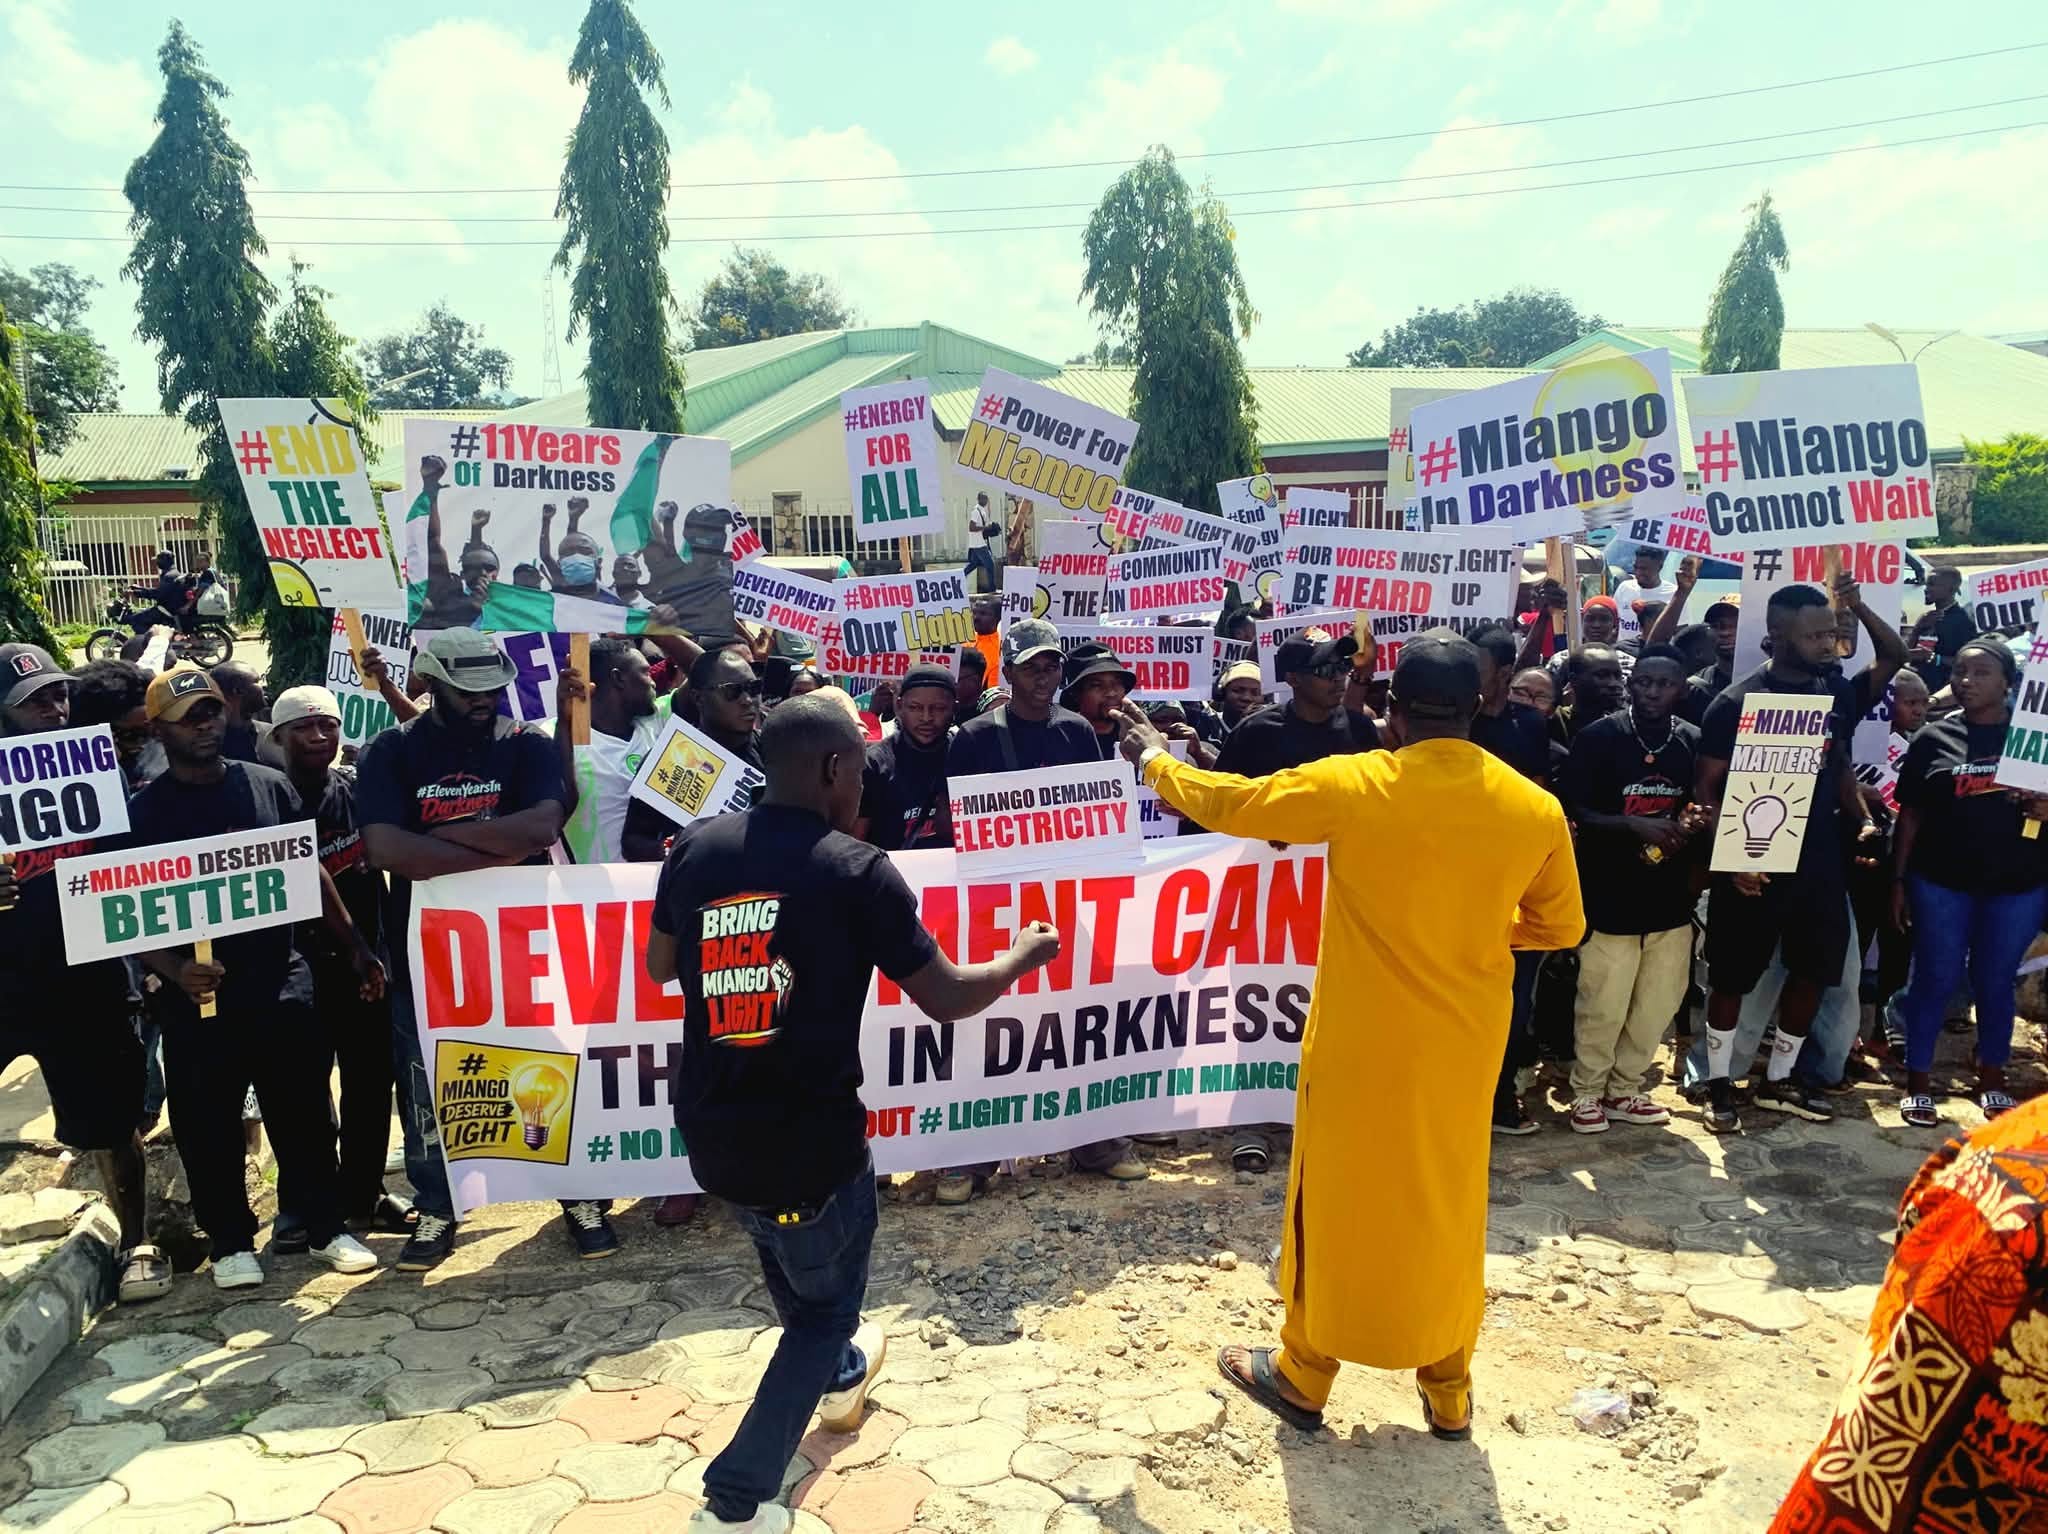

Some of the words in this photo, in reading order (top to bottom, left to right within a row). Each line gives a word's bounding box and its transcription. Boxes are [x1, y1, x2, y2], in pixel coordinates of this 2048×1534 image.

[844, 396, 925, 432] #ENERGY
[981, 393, 1085, 450] #Power
[1085, 429, 1129, 467] For
[235, 424, 357, 477] #END
[450, 423, 622, 466] #11Years
[866, 432, 911, 467] FOR
[1419, 392, 1668, 487] #Miango
[1694, 417, 1928, 485] #Miango
[454, 460, 482, 488] Of
[493, 463, 616, 493] Darkness
[957, 419, 1119, 513] Miango
[268, 480, 352, 525] THE
[861, 468, 928, 525] ALL
[1421, 495, 1459, 532] In
[1468, 453, 1675, 524] Darkness
[1705, 485, 1845, 536] Cannot
[1848, 477, 1934, 524] Wait
[262, 527, 384, 560] NEGLECT
[1151, 512, 1184, 535] #NO
[1184, 519, 1232, 547] LIGHT
[1231, 533, 1256, 555] NO
[1630, 518, 1664, 544] BE
[1039, 554, 1107, 576] #POWER
[1109, 546, 1223, 582] #COMMUNITY
[1286, 544, 1332, 566] #OUR
[1335, 547, 1397, 571] VOICES
[1400, 551, 1454, 574] MUST
[1753, 549, 1783, 581] #
[843, 581, 914, 612] #Bring
[915, 576, 964, 601] Back
[1062, 591, 1099, 617] THE
[1109, 589, 1126, 613] IN
[1129, 577, 1224, 611] DARKNESS
[1291, 571, 1329, 605] BE
[1332, 575, 1432, 614] HEARD
[1451, 583, 1481, 606] UP
[767, 604, 818, 636] POWE
[842, 618, 898, 656] Our
[901, 607, 977, 651] Light
[1372, 615, 1418, 636] MUST
[1976, 598, 2035, 632] Our
[1158, 636, 1203, 654] MUST
[685, 773, 706, 811] LIGHT
[950, 788, 1035, 816] #MIANGO
[1039, 779, 1123, 807] DEMANDS
[952, 802, 1128, 853] ELECTRICITY
[67, 855, 192, 897] #MIANGO
[198, 836, 314, 877] DESERVES
[100, 868, 288, 945] BETTER
[702, 900, 780, 940] BRING
[700, 931, 774, 972] BACK
[702, 966, 769, 998] MIANGO
[707, 992, 778, 1037] LIGHT
[888, 1022, 955, 1087] IN
[984, 982, 1312, 1078] DARKNESS
[457, 1053, 489, 1076] #
[442, 1079, 509, 1102] MIANGO
[444, 1103, 506, 1121] DESERVE
[619, 1128, 663, 1161] NO
[948, 1094, 1029, 1132] LIGHT
[1032, 1090, 1060, 1122] IS
[1064, 1087, 1083, 1116] A
[1087, 1070, 1162, 1112] RIGHT
[1167, 1067, 1194, 1097] IN
[1199, 1061, 1299, 1095] MIANGO
[443, 1121, 516, 1149] LIGHT
